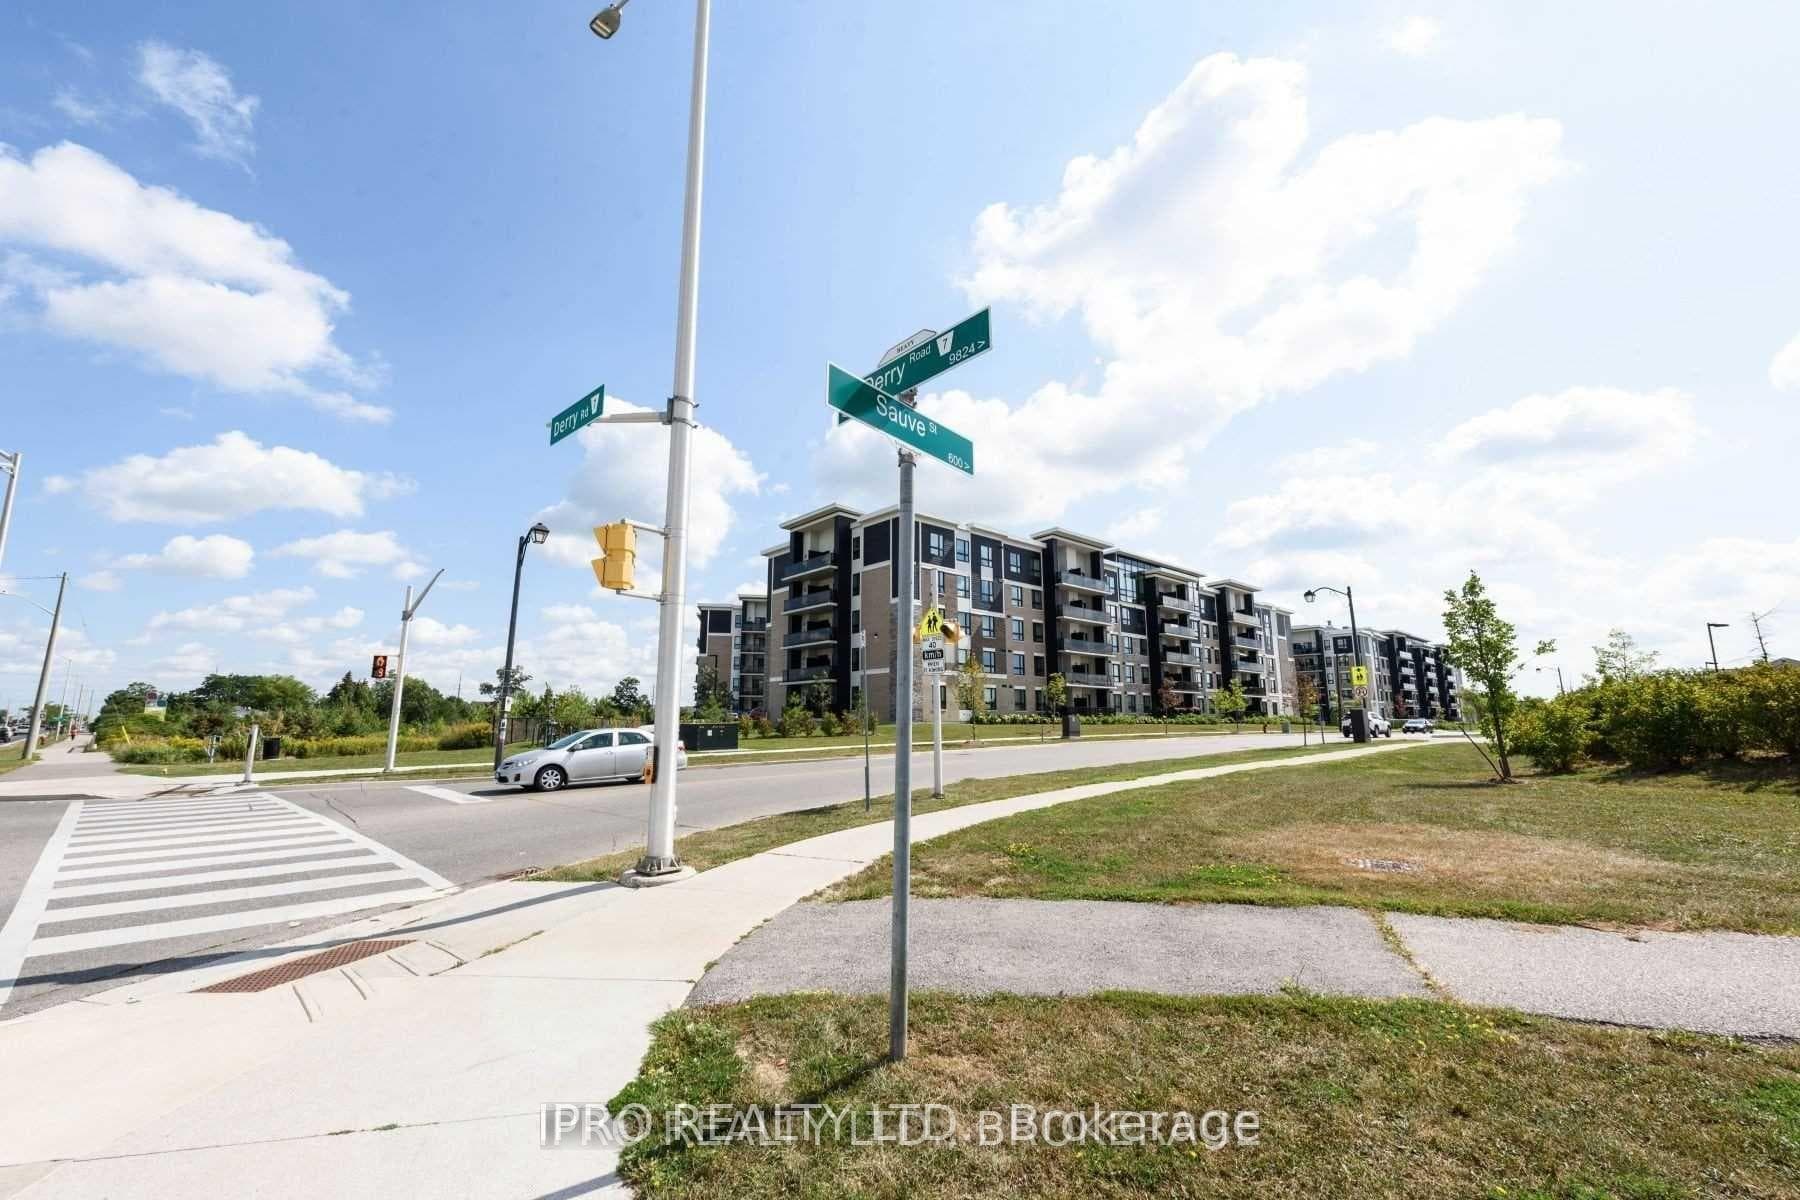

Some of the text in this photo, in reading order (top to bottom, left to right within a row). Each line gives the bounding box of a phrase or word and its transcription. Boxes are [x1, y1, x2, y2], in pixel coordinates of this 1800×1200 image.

[909, 344, 931, 364] Road
[942, 337, 948, 351] 7
[949, 342, 975, 365] 9824
[553, 407, 589, 437] Derry Rd
[876, 394, 937, 437] Sauve St
[928, 641, 937, 649] 40
